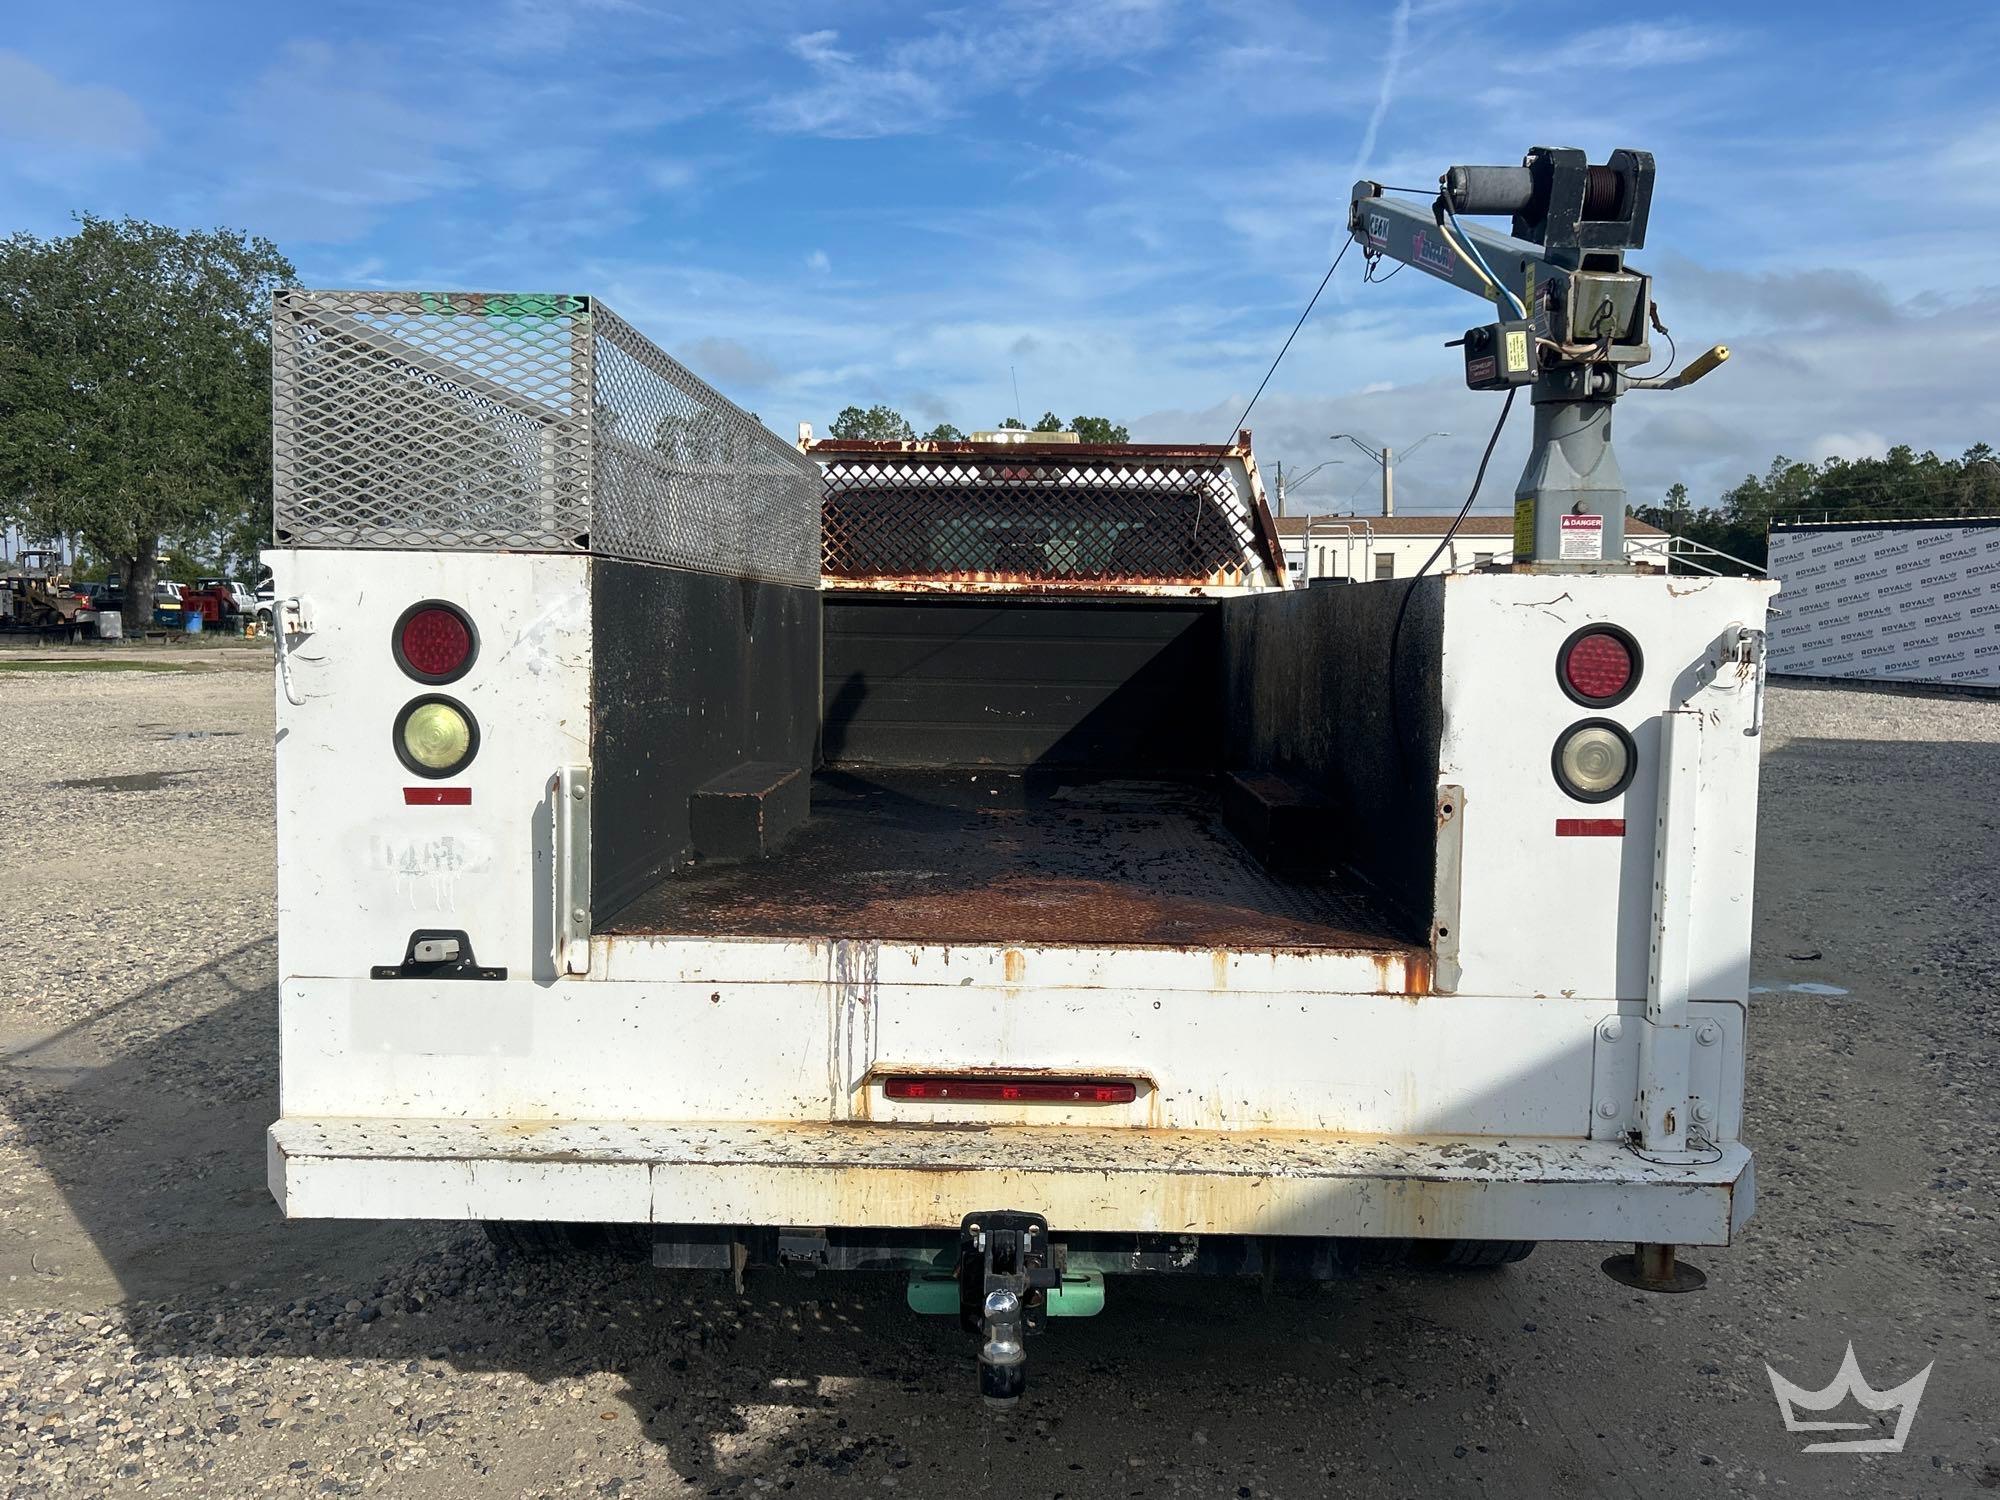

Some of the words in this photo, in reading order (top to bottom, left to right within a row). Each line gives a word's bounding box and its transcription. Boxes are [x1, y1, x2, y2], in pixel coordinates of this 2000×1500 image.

[1851, 533, 1876, 543] ROYAL
[1917, 536, 1944, 546] ROYAL
[1812, 544, 1836, 554] ROYAL
[1874, 546, 1901, 556] ROYAL
[1774, 554, 1797, 563] ROYAL
[1940, 550, 1968, 560] ROYAL
[1834, 556, 1858, 566] ROYAL
[1896, 561, 1922, 571] ROYAL
[1796, 566, 1818, 576] ROYAL
[1966, 564, 1995, 574] ROYAL
[1854, 570, 1879, 580] ROYAL
[1921, 575, 1948, 584] ROYAL
[1815, 580, 1839, 590] ROYAL
[1878, 584, 1904, 594] ROYAL
[1778, 590, 1800, 599] ROYAL
[1838, 594, 1861, 603] ROYAL
[1944, 589, 1972, 600] ROYAL
[1799, 603, 1822, 612] ROYAL
[1900, 598, 1927, 609] ROYAL
[1858, 608, 1882, 618] ROYAL
[1970, 604, 1999, 614] ROYAL
[1819, 617, 1842, 626] ROYAL
[1925, 613, 1952, 623] ROYAL
[1781, 626, 1803, 634] ROYAL
[1882, 622, 1908, 632] ROYAL
[1841, 631, 1865, 640] ROYAL
[1948, 629, 1976, 639] ROYAL
[1802, 639, 1825, 648] ROYAL
[1903, 638, 1930, 647] ROYAL
[1861, 645, 1887, 655] ROYAL
[1822, 654, 1846, 663] ROYAL
[1928, 652, 1956, 662] ROYAL
[1784, 661, 1806, 670] ROYAL
[1885, 660, 1911, 670] ROYAL
[1951, 669, 1980, 678] ROYAL
